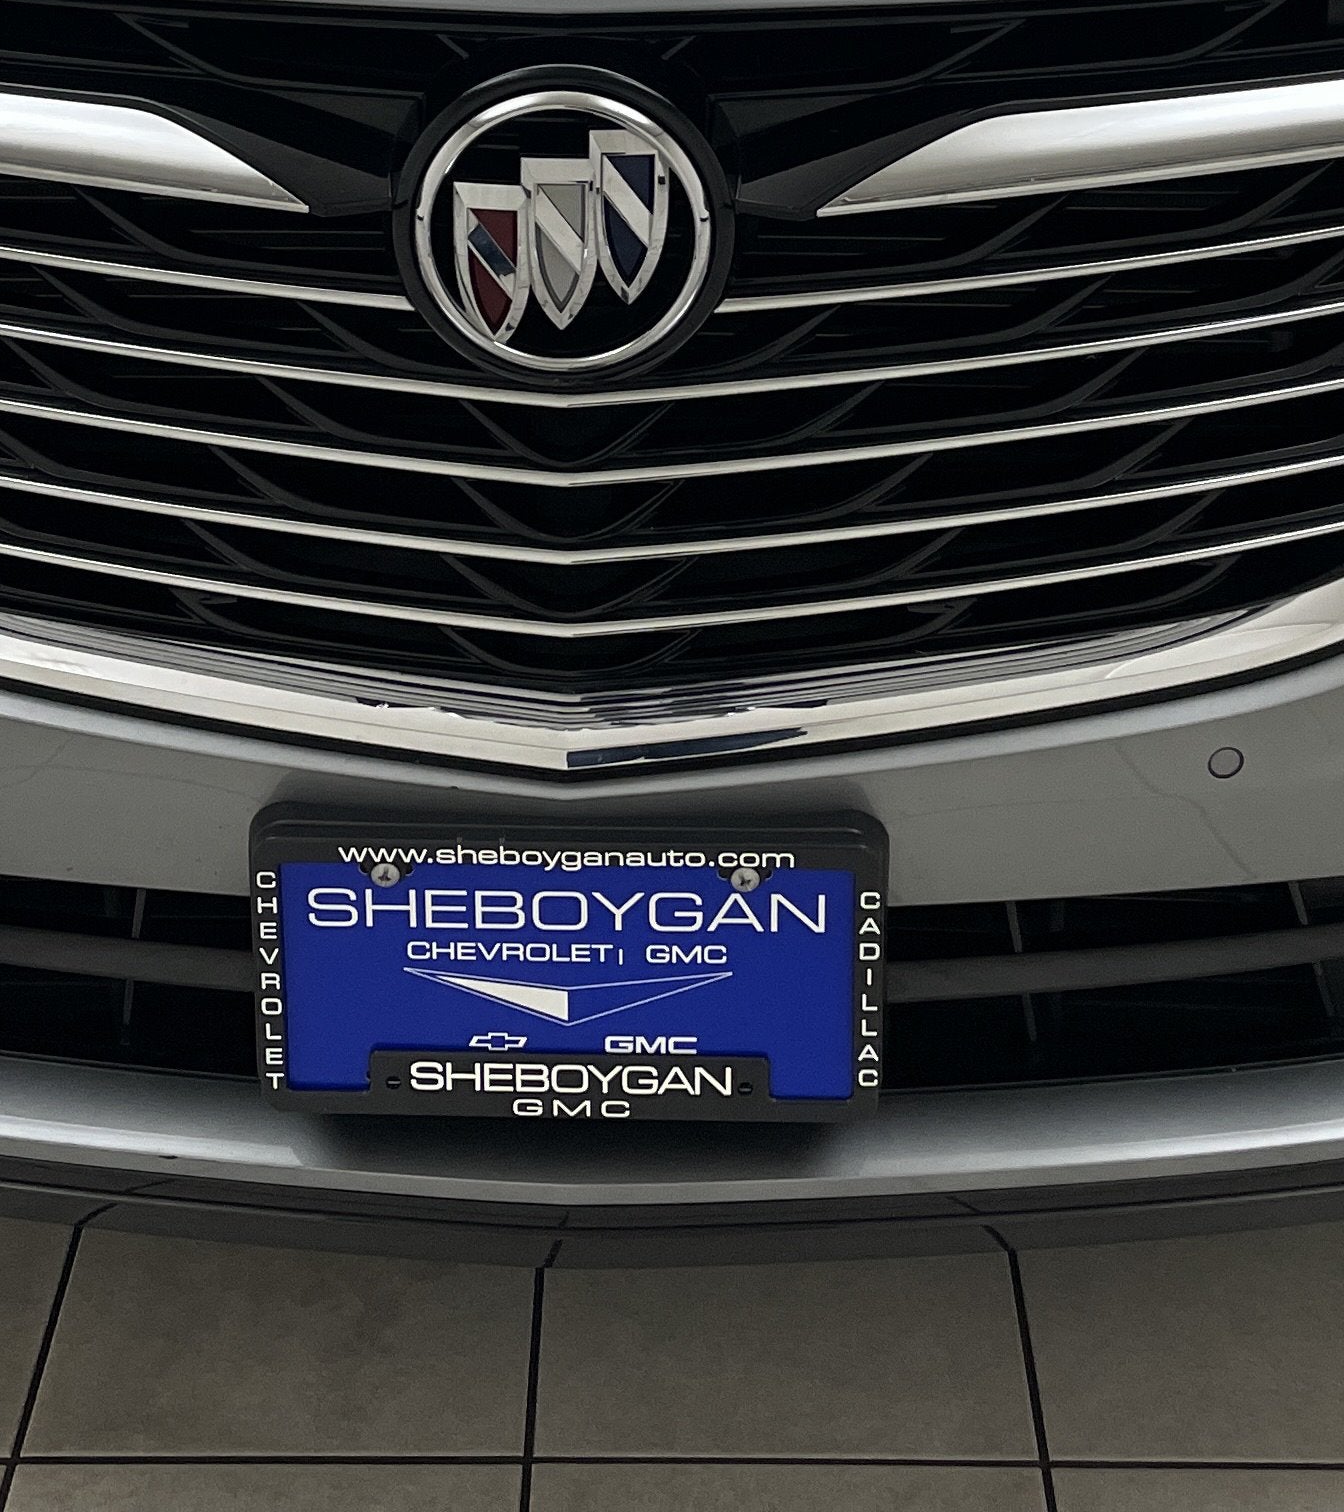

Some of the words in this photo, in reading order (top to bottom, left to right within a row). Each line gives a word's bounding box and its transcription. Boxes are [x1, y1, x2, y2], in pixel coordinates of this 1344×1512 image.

[337, 844, 795, 872] www.sheboyganauto.com
[307, 887, 826, 933] SHEBOYGAN
[407, 941, 614, 964] CHEVROLET
[645, 944, 728, 964] GMC
[256, 871, 285, 1090] CHEVROLET
[857, 891, 881, 1087] CADILLAC
[604, 1035, 698, 1055] GMC
[410, 1061, 732, 1096] SHEBOYGAN
[512, 1098, 631, 1118] GMC
